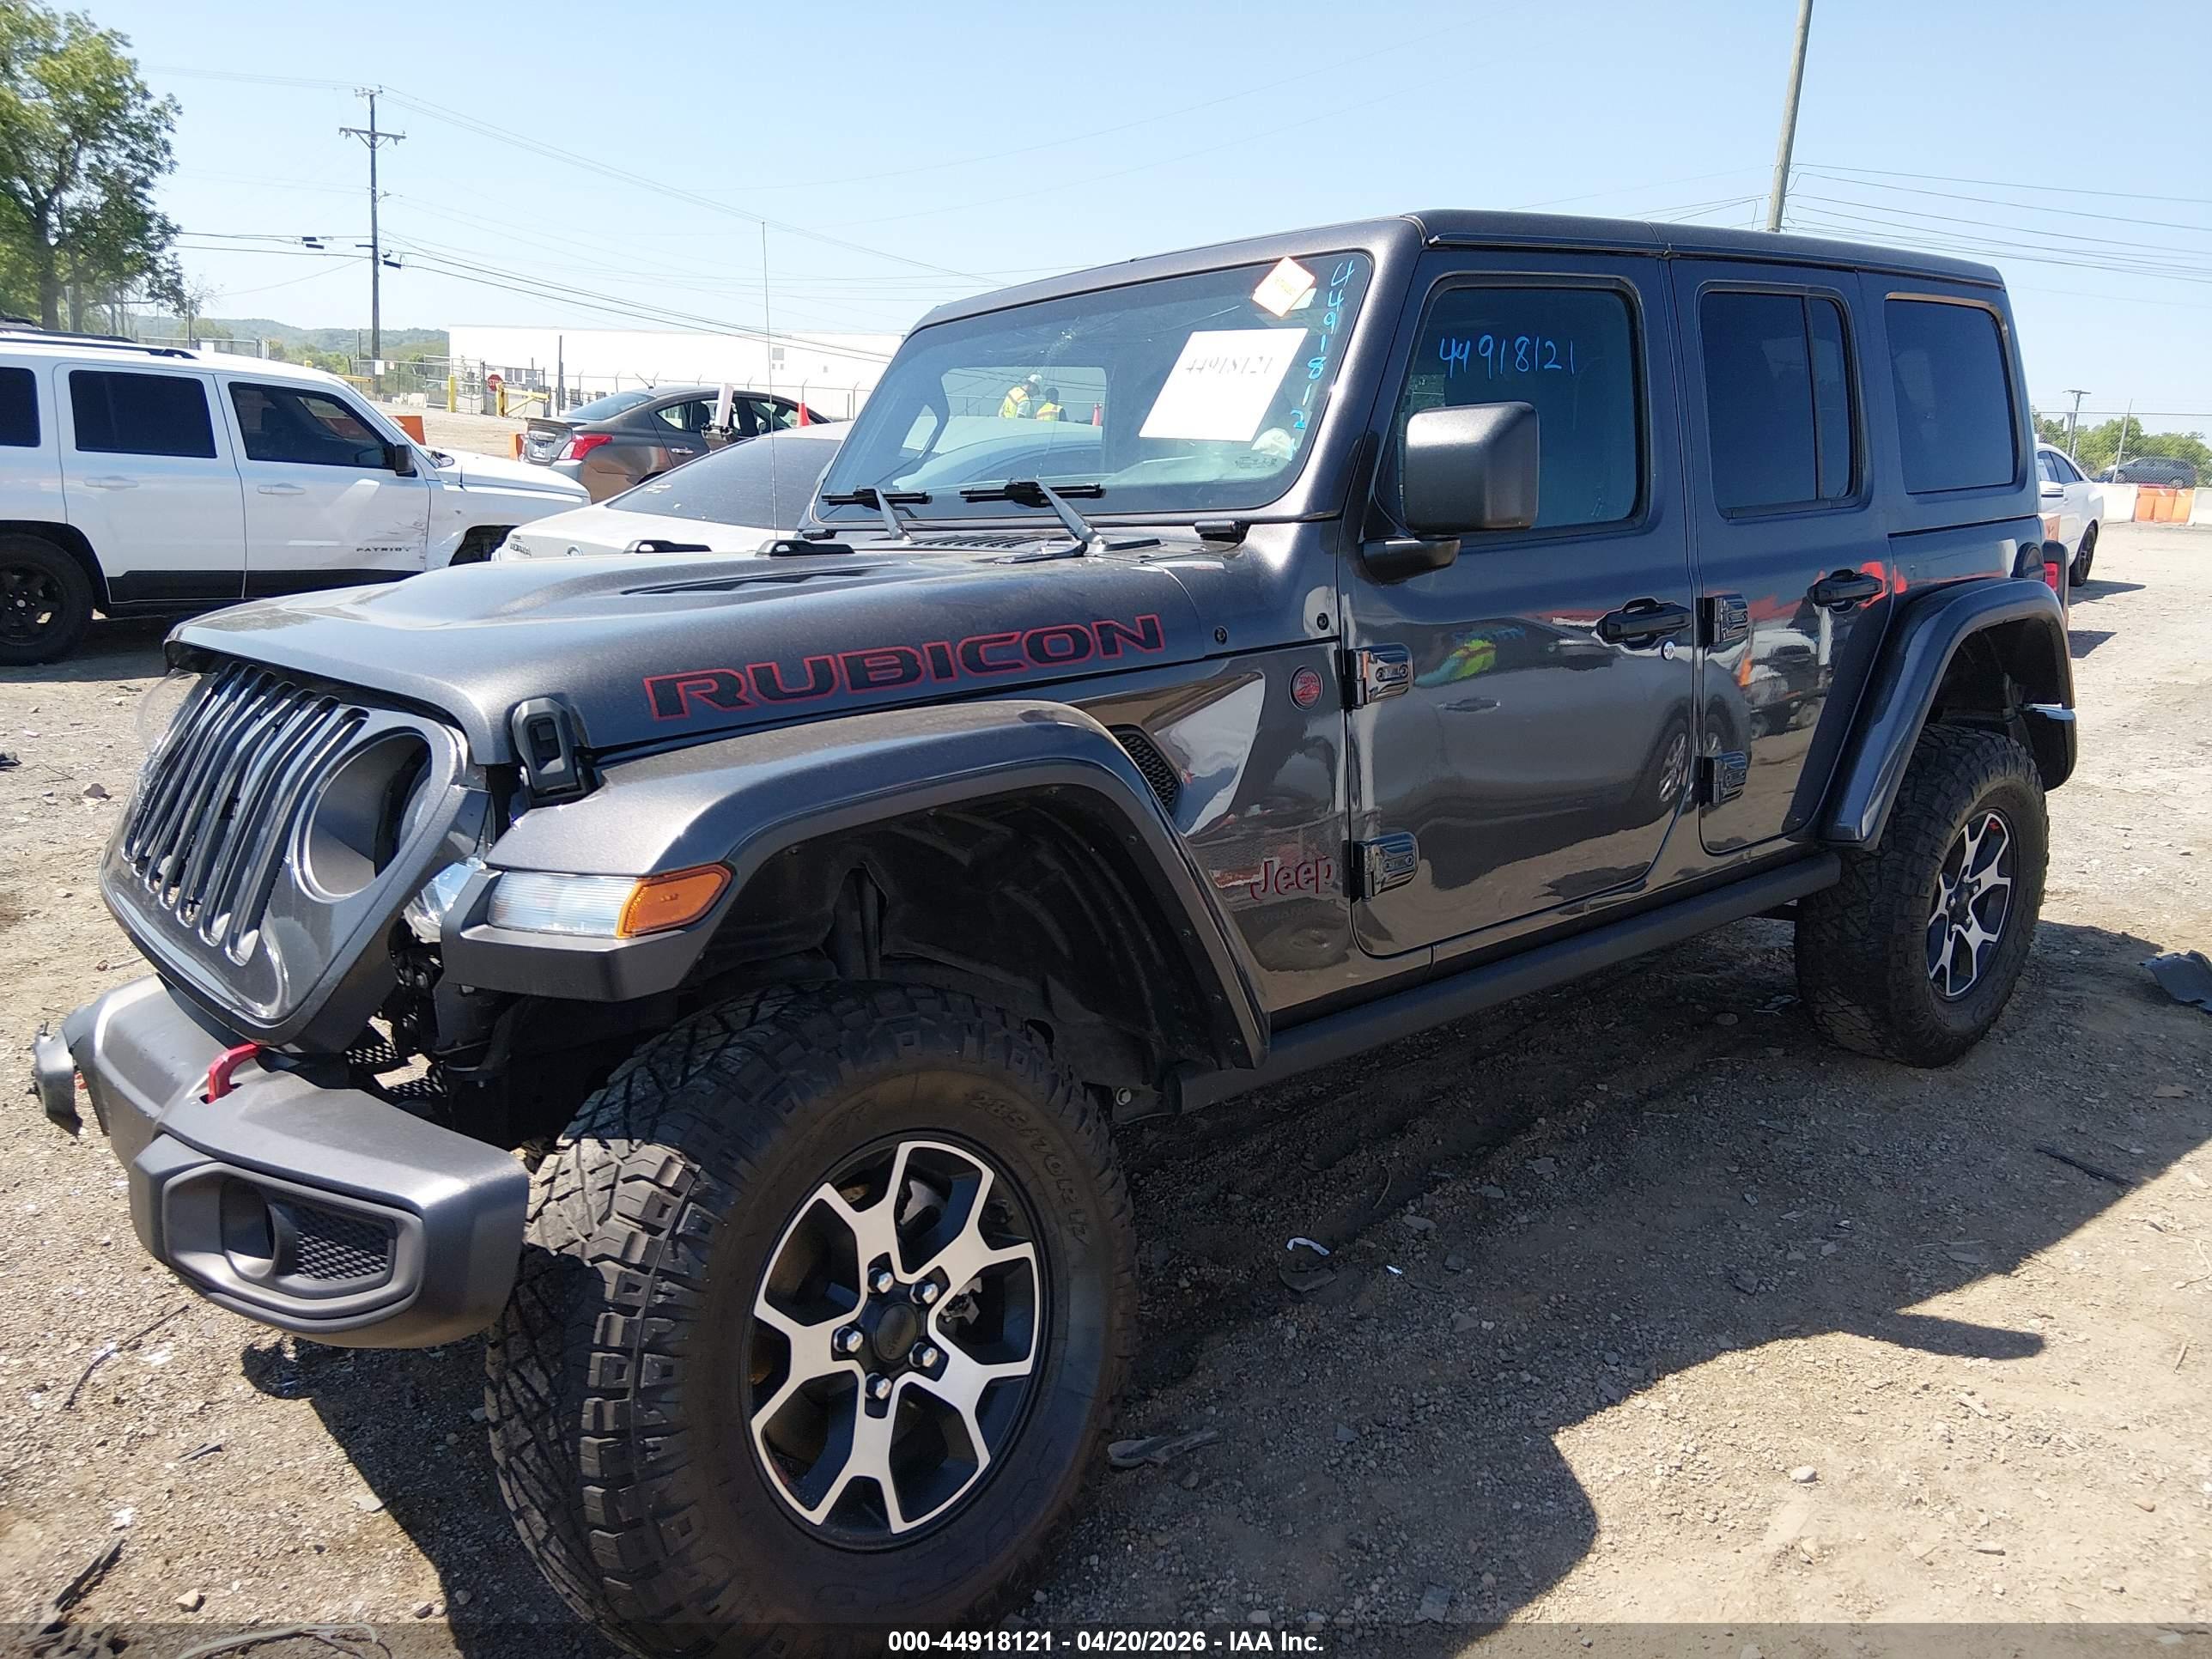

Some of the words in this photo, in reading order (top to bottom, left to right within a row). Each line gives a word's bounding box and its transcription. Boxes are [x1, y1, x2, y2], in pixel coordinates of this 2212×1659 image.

[1439, 334, 1575, 380] 44918121
[642, 613, 1166, 721] RUBICON
[1249, 856, 1337, 902] Jeep
